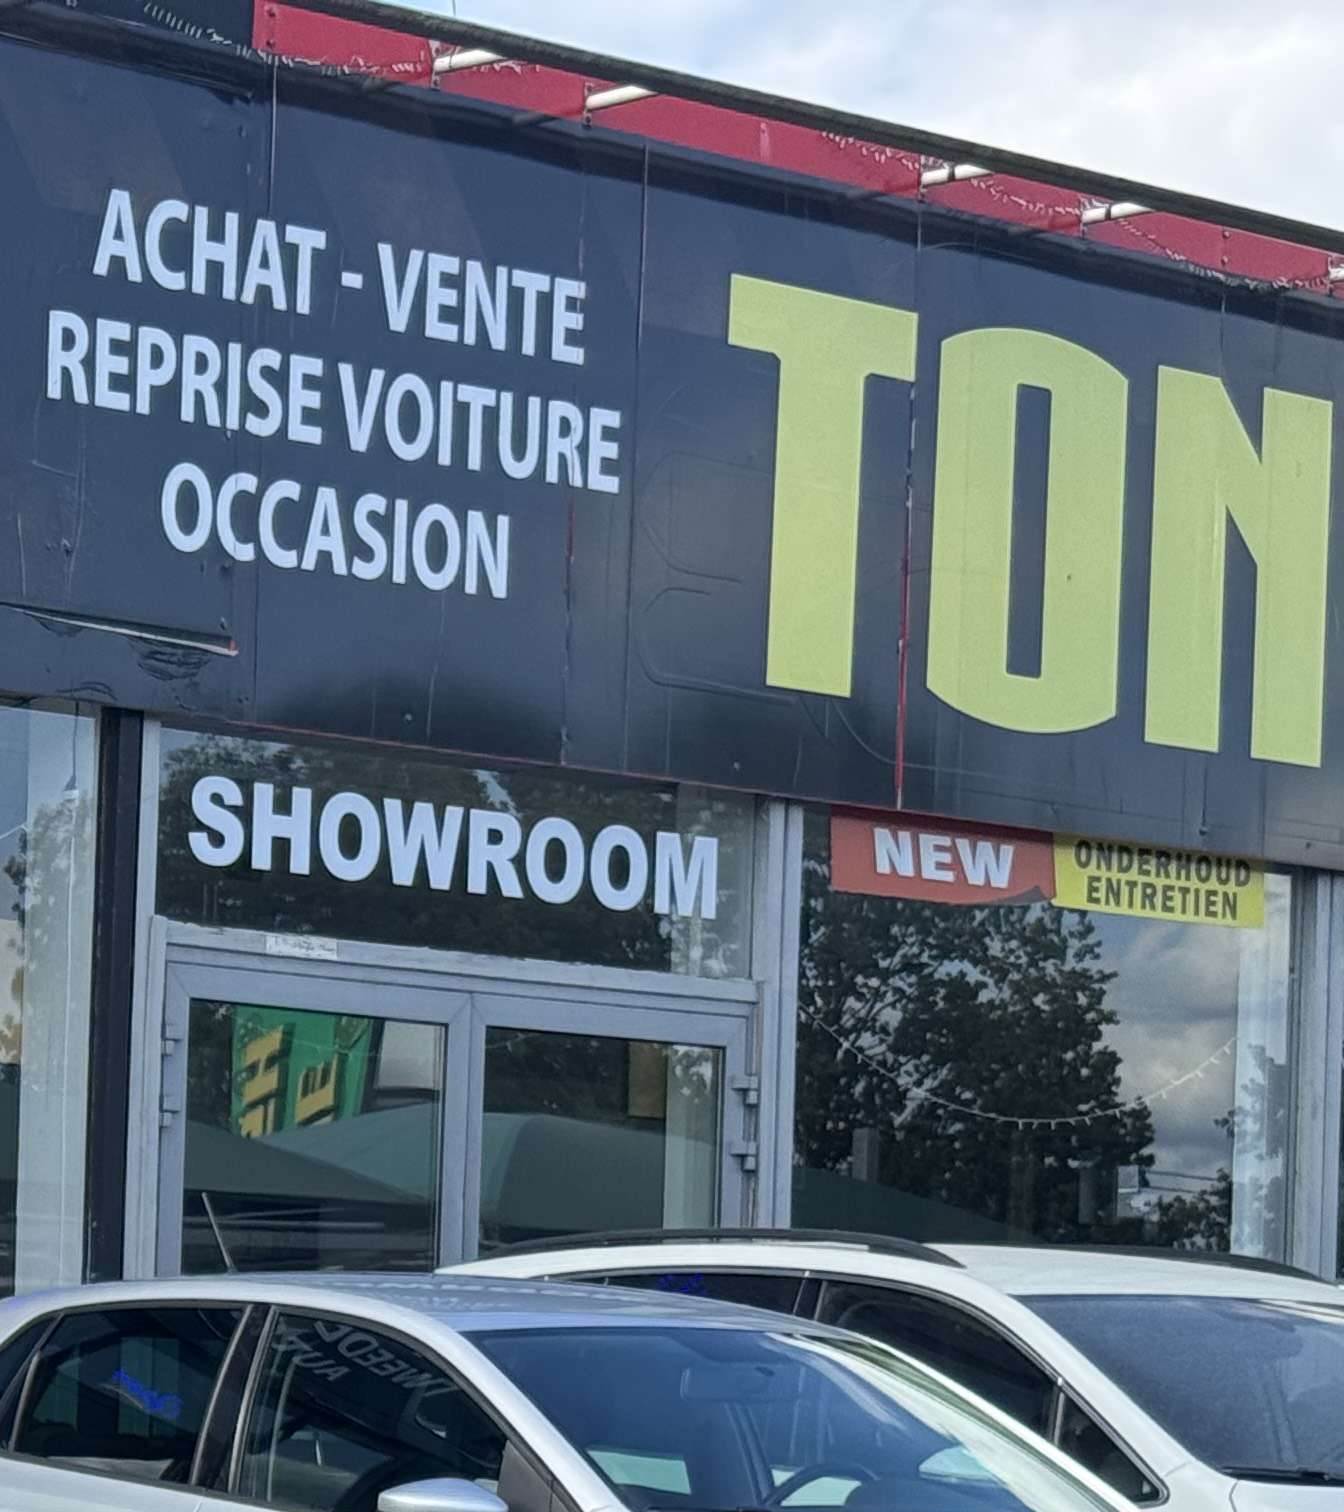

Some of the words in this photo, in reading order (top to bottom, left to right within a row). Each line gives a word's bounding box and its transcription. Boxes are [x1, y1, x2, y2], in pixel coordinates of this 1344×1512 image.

[92, 188, 326, 315] ACHAT
[378, 243, 586, 365] VENTE
[47, 309, 323, 445] REPRISE
[337, 363, 621, 494] VOITURE
[161, 462, 510, 599] OCCASION
[728, 273, 1333, 768] TON
[187, 775, 718, 919] SHOWROOM
[873, 828, 1015, 889] NEW
[1073, 838, 1251, 888] ONDERHOUD
[1086, 876, 1238, 922] ENTRETIEN
